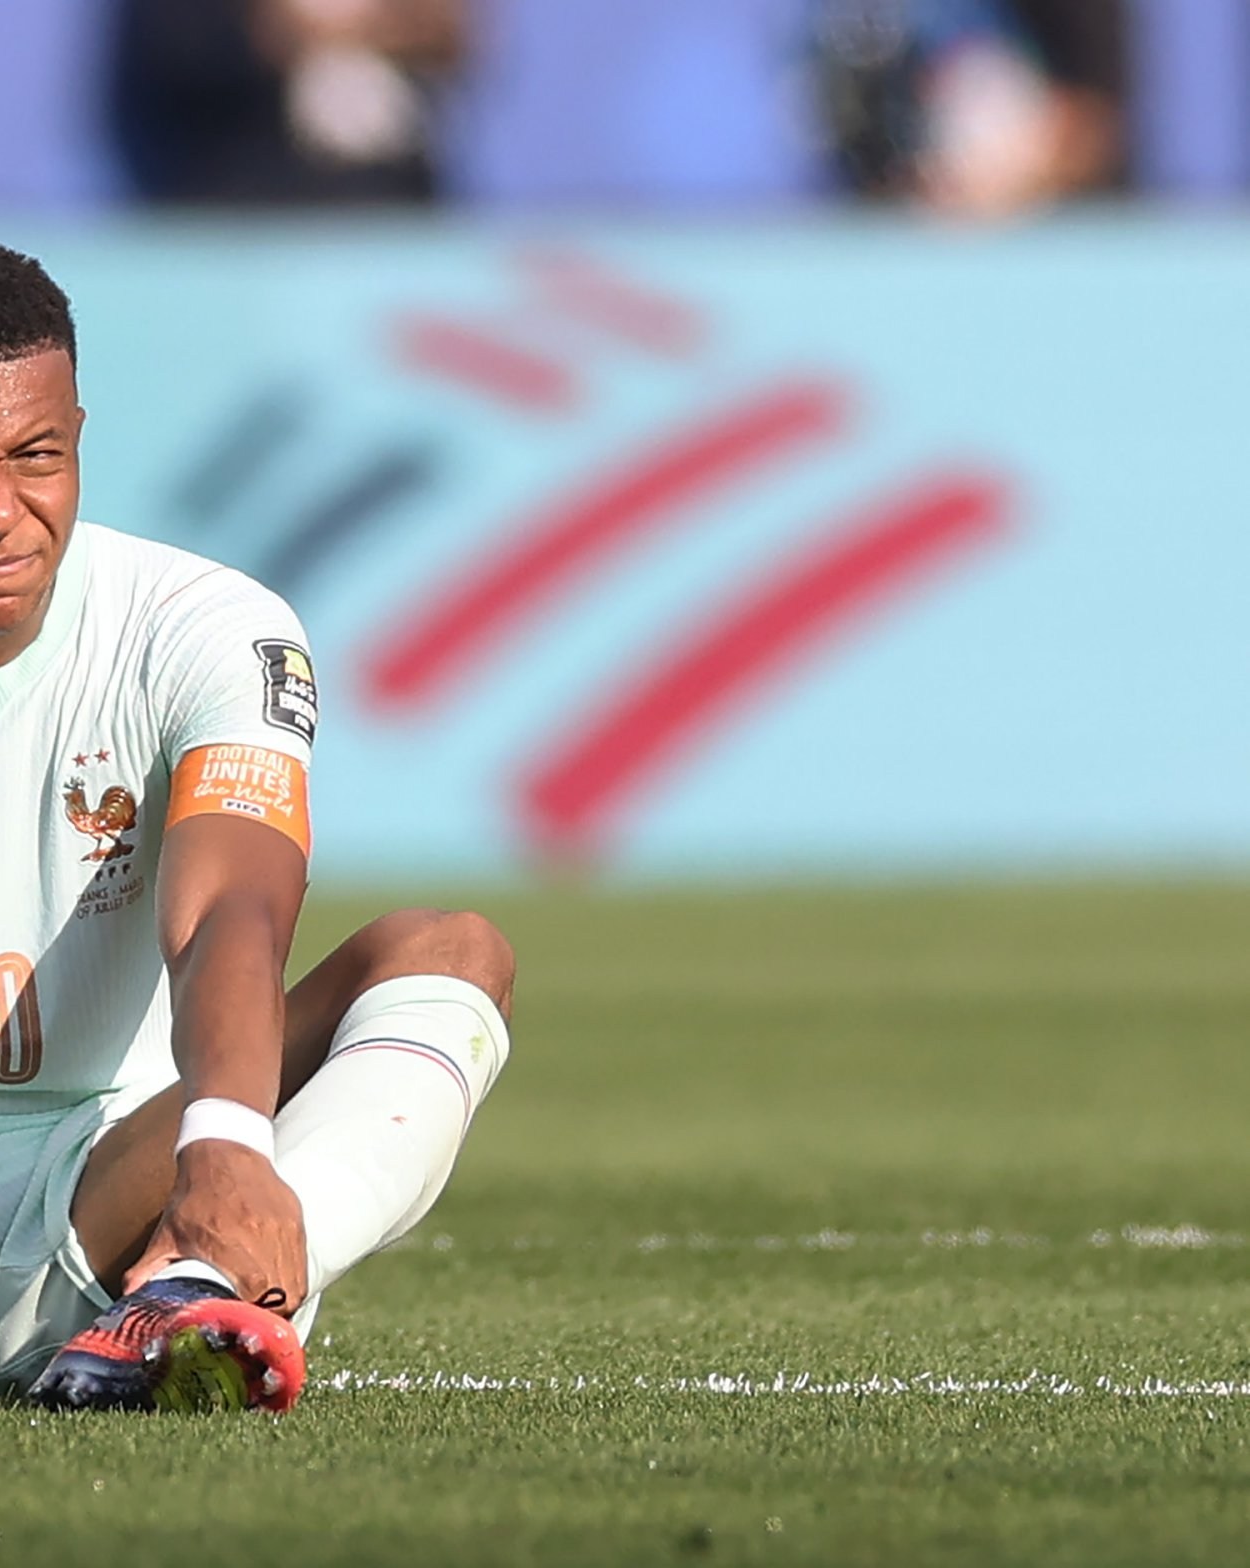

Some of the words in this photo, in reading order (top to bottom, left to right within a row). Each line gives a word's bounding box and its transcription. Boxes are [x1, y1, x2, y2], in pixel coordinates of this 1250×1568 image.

[205, 745, 291, 780] FOOTBALL
[200, 762, 291, 799] UNITES
[193, 782, 231, 798] the
[233, 783, 294, 818] World
[225, 800, 262, 815] FIFA
